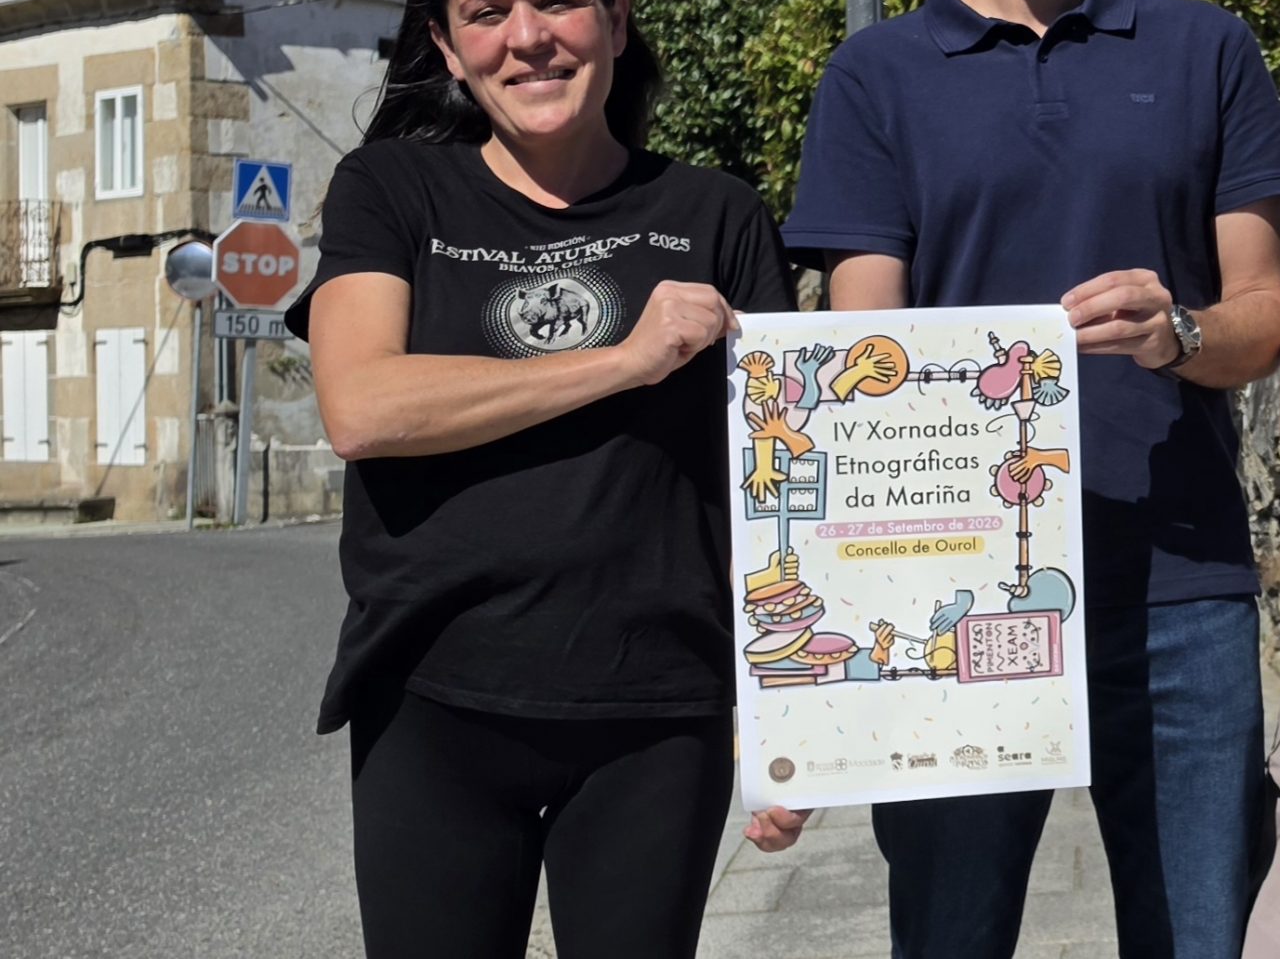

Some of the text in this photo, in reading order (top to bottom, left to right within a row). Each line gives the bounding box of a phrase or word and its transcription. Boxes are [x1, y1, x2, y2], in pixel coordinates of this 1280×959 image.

[535, 234, 641, 264] ATURUXO
[648, 232, 690, 252] 2025
[222, 251, 294, 276] STOP
[499, 263, 558, 273] BRAVOS,
[226, 316, 285, 334] 150 m
[834, 416, 980, 442] IV Xornadas
[835, 449, 980, 479] Etnográficas
[845, 485, 971, 508] da Mariña
[819, 525, 836, 537] 26
[847, 523, 864, 535] 27
[868, 522, 884, 534] de
[887, 520, 944, 534] Setembro
[949, 519, 963, 531] de
[967, 517, 1000, 530] 2026
[845, 539, 976, 557] Concello de Ourol
